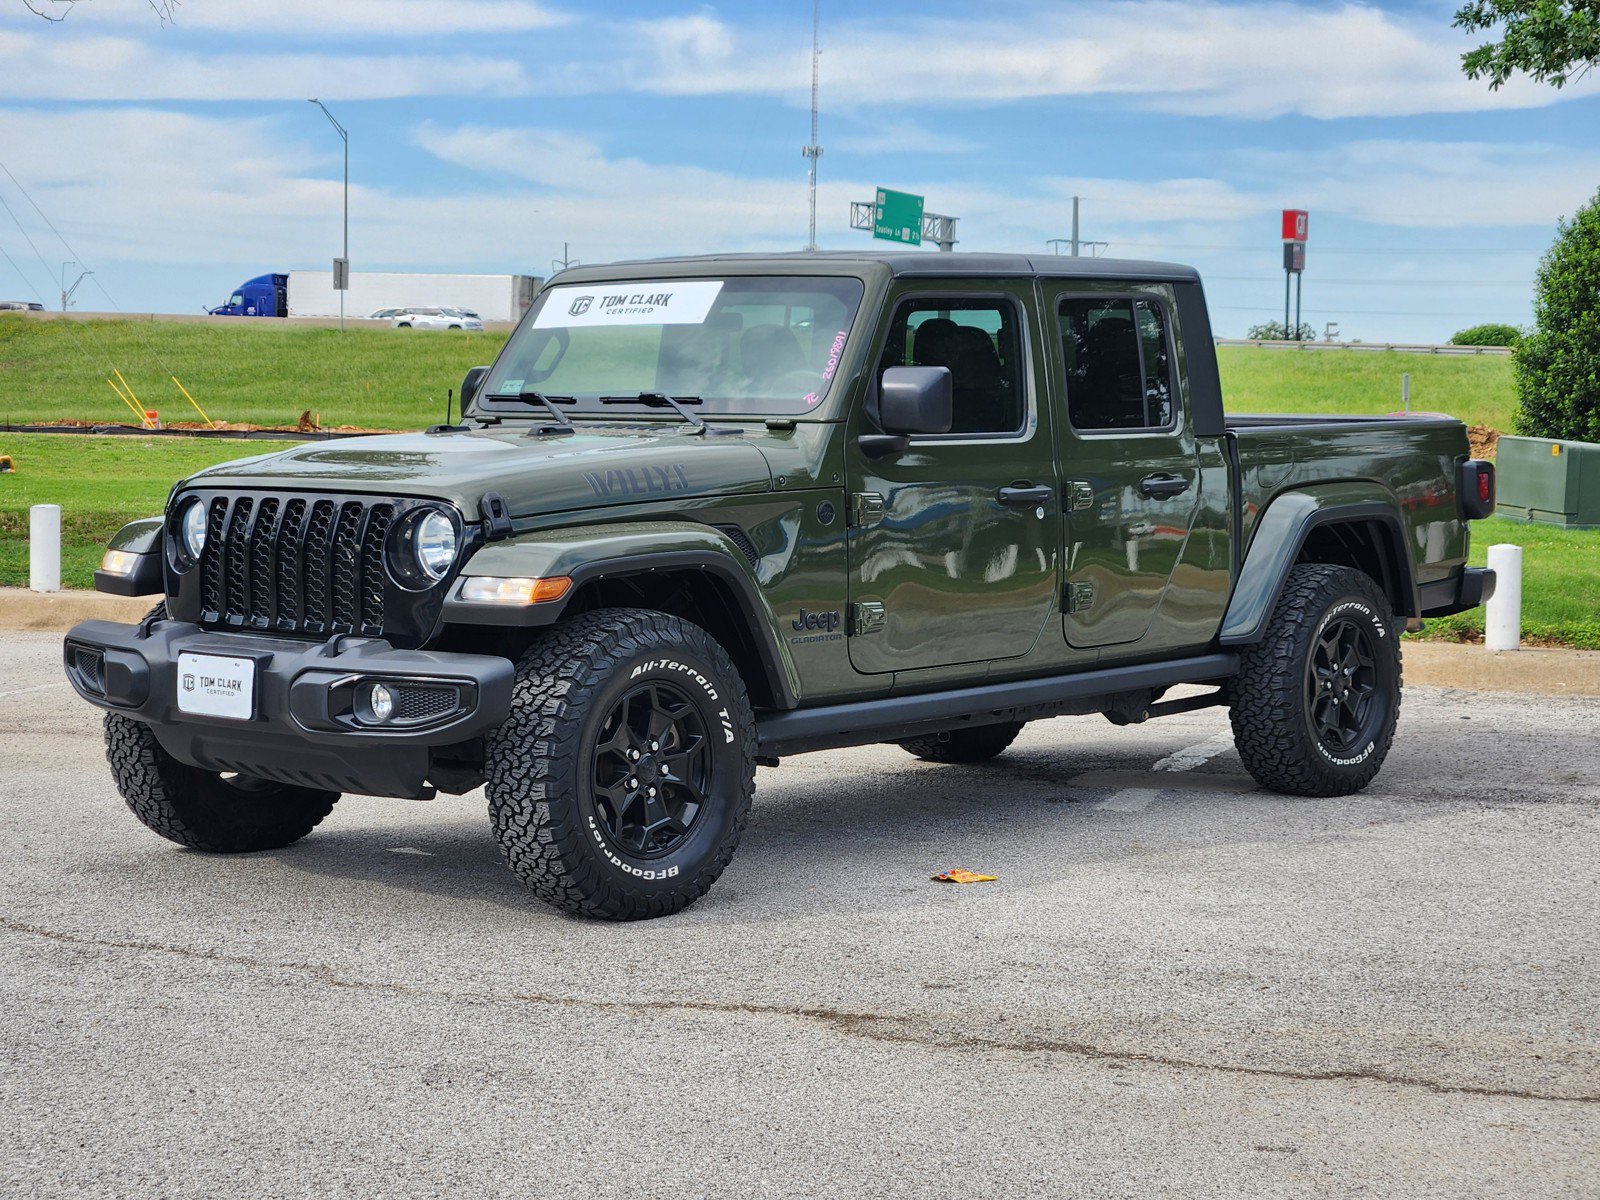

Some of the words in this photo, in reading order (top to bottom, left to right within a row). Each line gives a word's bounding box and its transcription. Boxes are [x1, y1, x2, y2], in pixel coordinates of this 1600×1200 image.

[599, 294, 626, 308] TOM
[628, 293, 674, 307] CLARK
[605, 307, 654, 315] CERTIFIED
[581, 463, 689, 497] WILLYS
[792, 607, 840, 633] Jeep
[1371, 614, 1386, 638] T/A
[791, 633, 842, 645] GLADIATOR
[200, 676, 216, 688] TOM
[217, 678, 242, 692] CLARK
[206, 688, 235, 697] CERTIFIED
[630, 659, 719, 701] All-Terrain
[718, 706, 735, 744] T/A
[588, 815, 680, 881] BFGoodrich
